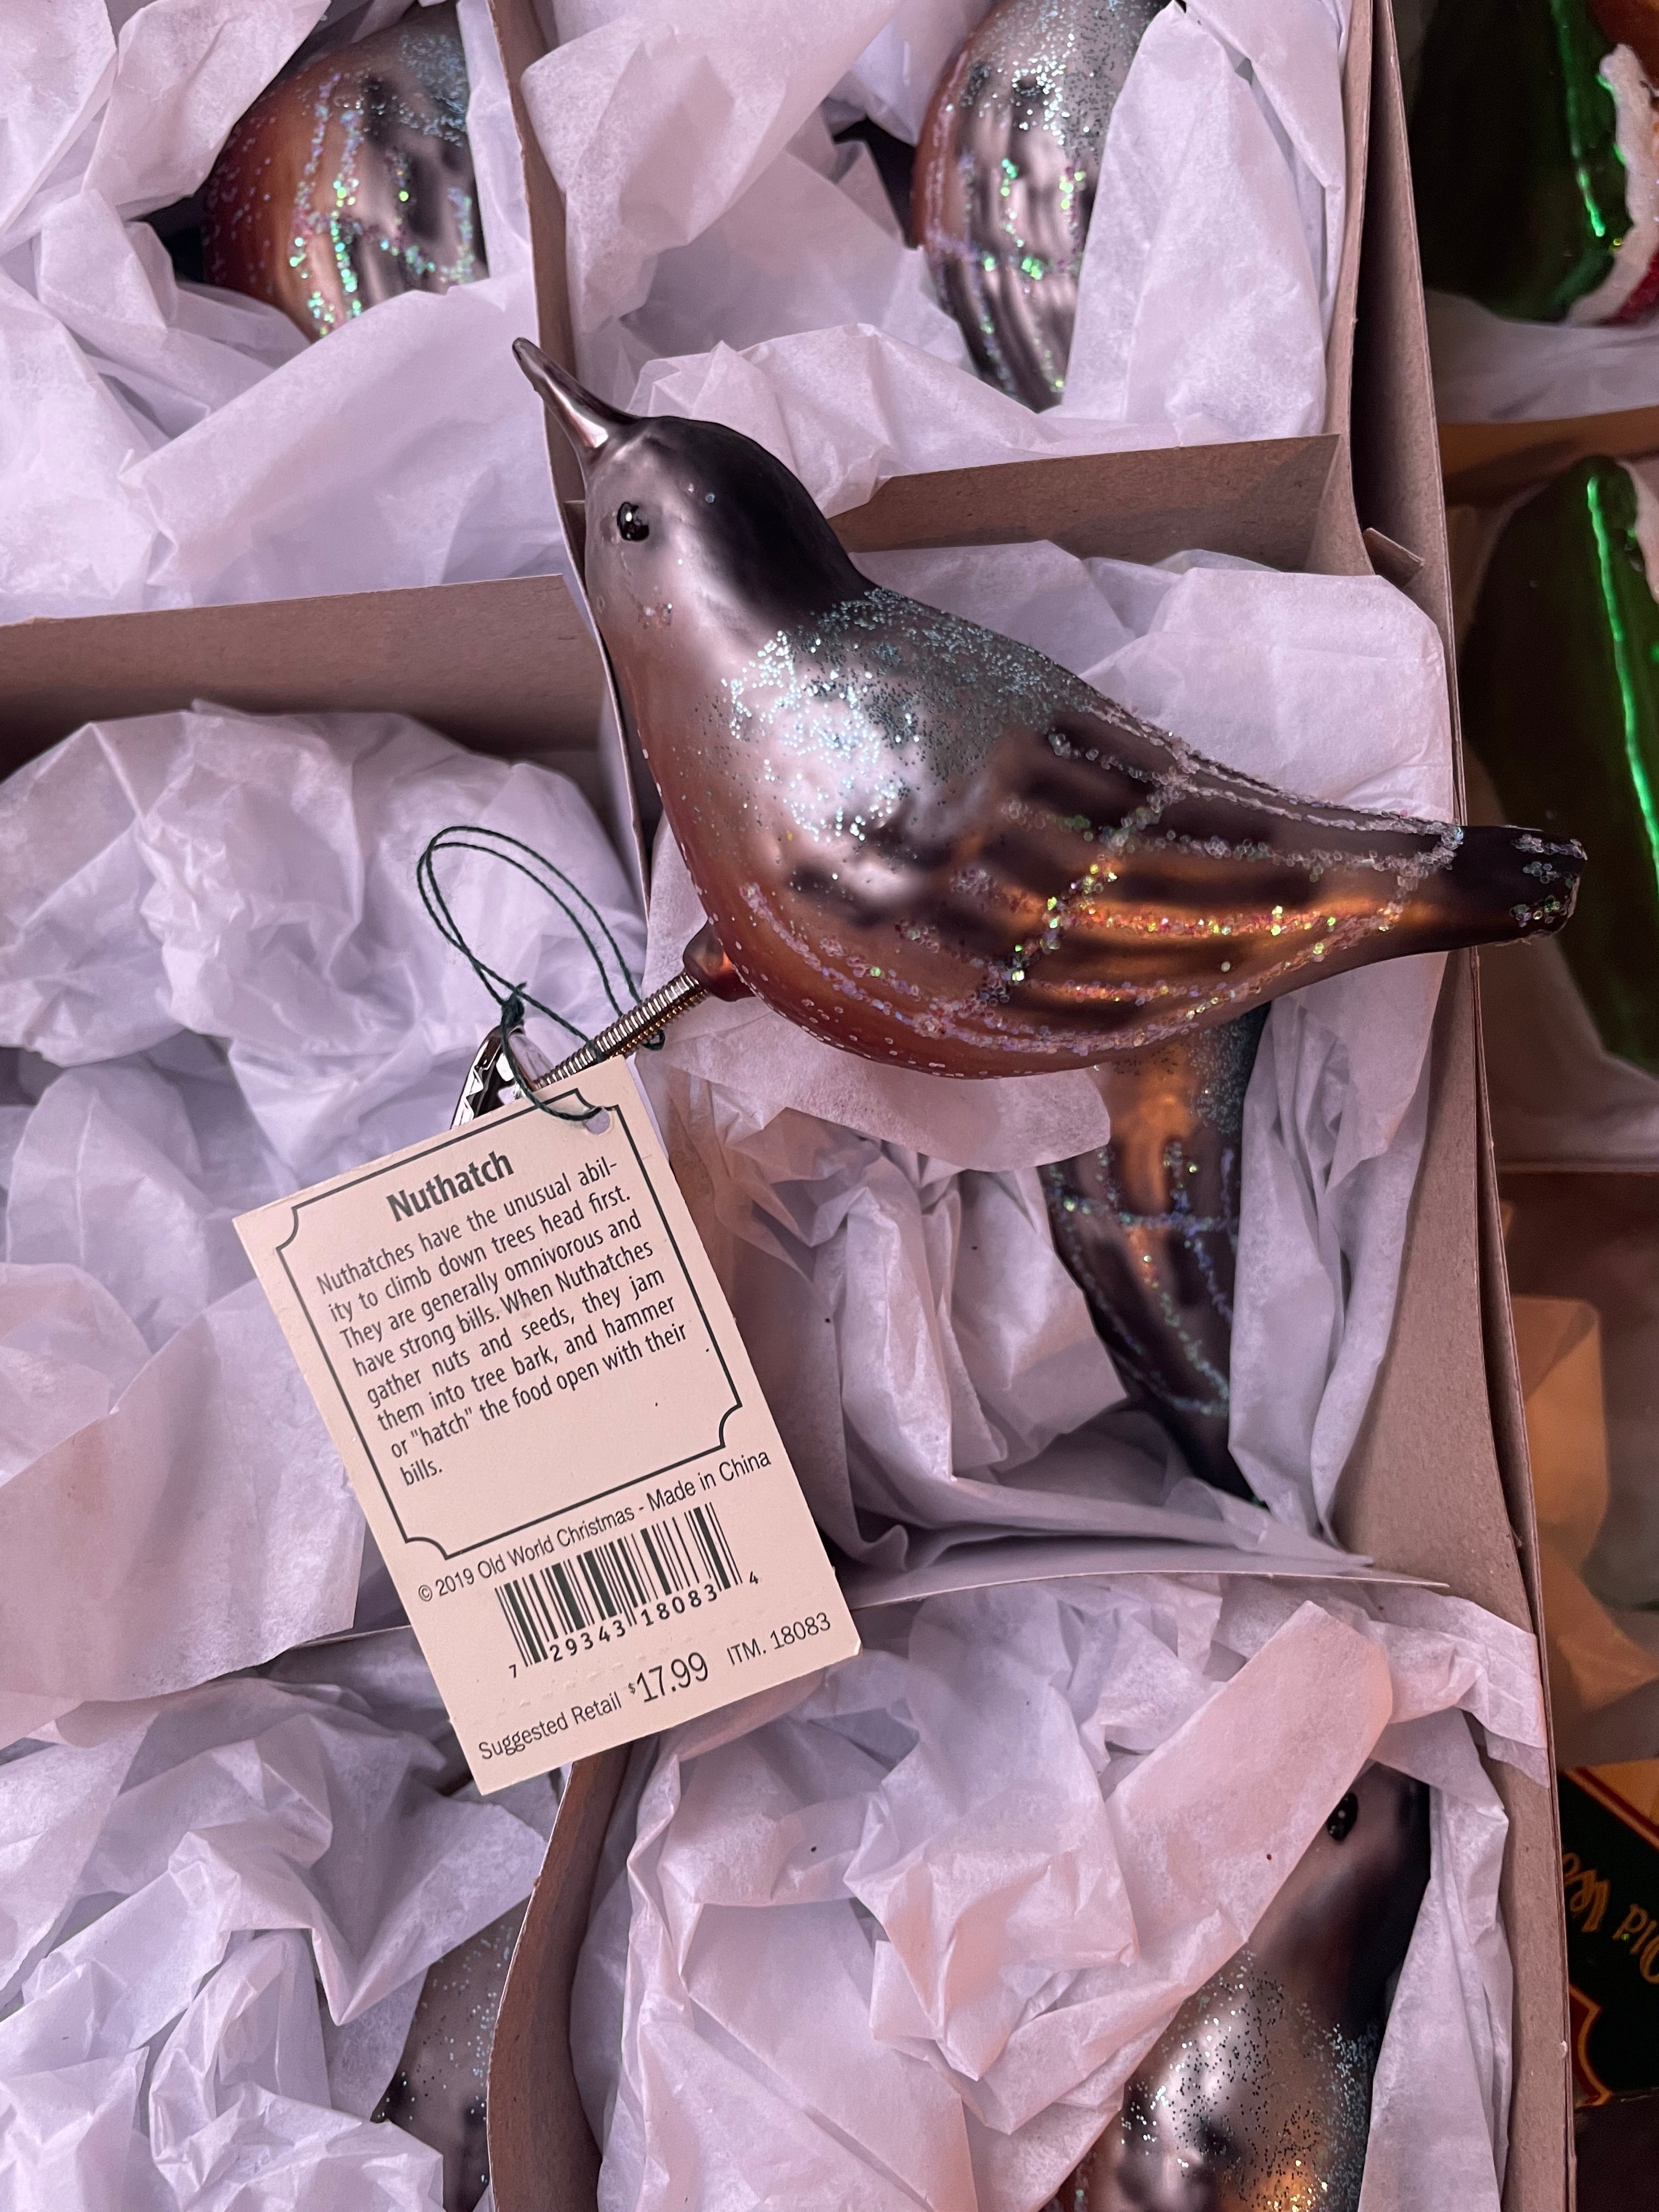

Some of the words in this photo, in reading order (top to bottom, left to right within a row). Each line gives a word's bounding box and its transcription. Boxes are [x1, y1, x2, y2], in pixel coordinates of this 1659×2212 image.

[316, 1243, 415, 1295] Nuthatches
[417, 1224, 462, 1252] have
[466, 1209, 498, 1232] the
[503, 1172, 572, 1217] unusual
[577, 1156, 617, 1186] abil-
[328, 1301, 353, 1323] ity
[358, 1291, 379, 1310] to
[385, 1266, 432, 1299] climb
[438, 1246, 487, 1277] down
[490, 1225, 535, 1254] trees
[538, 1199, 585, 1234] head
[588, 1185, 630, 1214] first.
[386, 1150, 515, 1223] Nuthatch
[339, 1321, 382, 1349] They
[387, 1308, 416, 1331] are
[421, 1271, 498, 1322] generally
[505, 1229, 604, 1282] omnivorous
[607, 1207, 642, 1239] and
[352, 1349, 396, 1377] have
[399, 1324, 456, 1359] strong
[455, 1305, 500, 1334] bills.
[499, 1283, 554, 1314] When
[555, 1241, 653, 1293] Nuthatches
[367, 1369, 421, 1409] gather
[431, 1350, 471, 1378] nuts
[479, 1327, 513, 1357] and
[521, 1306, 574, 1340] seeds,
[582, 1286, 620, 1314] they
[629, 1270, 665, 1301] jam
[377, 1402, 425, 1431] them
[428, 1385, 465, 1410] into
[471, 1368, 507, 1392] tree
[510, 1345, 558, 1376] bark,
[563, 1323, 598, 1355] and
[601, 1296, 675, 1339] hammer
[391, 1439, 408, 1458] or
[410, 1407, 472, 1447] "hatch"
[479, 1398, 510, 1421] the
[512, 1375, 553, 1408] food
[556, 1362, 600, 1392] open
[601, 1340, 643, 1370] with
[645, 1323, 686, 1353] their
[399, 1458, 443, 1486] bills.
[418, 1584, 433, 1602] ©
[435, 1568, 475, 1597] 2019
[477, 1553, 507, 1579] Old
[506, 1534, 555, 1567] World
[556, 1506, 635, 1548] Christmas
[646, 1480, 696, 1512] Made
[697, 1472, 717, 1491] in
[719, 1452, 772, 1482] China
[478, 1711, 569, 1760] Suggested
[571, 1691, 622, 1725] Retail
[628, 1652, 708, 1703] $17.99
[726, 1638, 766, 1666] ITM.
[770, 1612, 831, 1650] 18083
[508, 1663, 517, 1679] 7
[549, 1620, 626, 1663] 29343
[640, 1583, 718, 1627] 18083
[749, 1571, 759, 1585] 4
[1563, 1853, 1608, 1932] Wo
